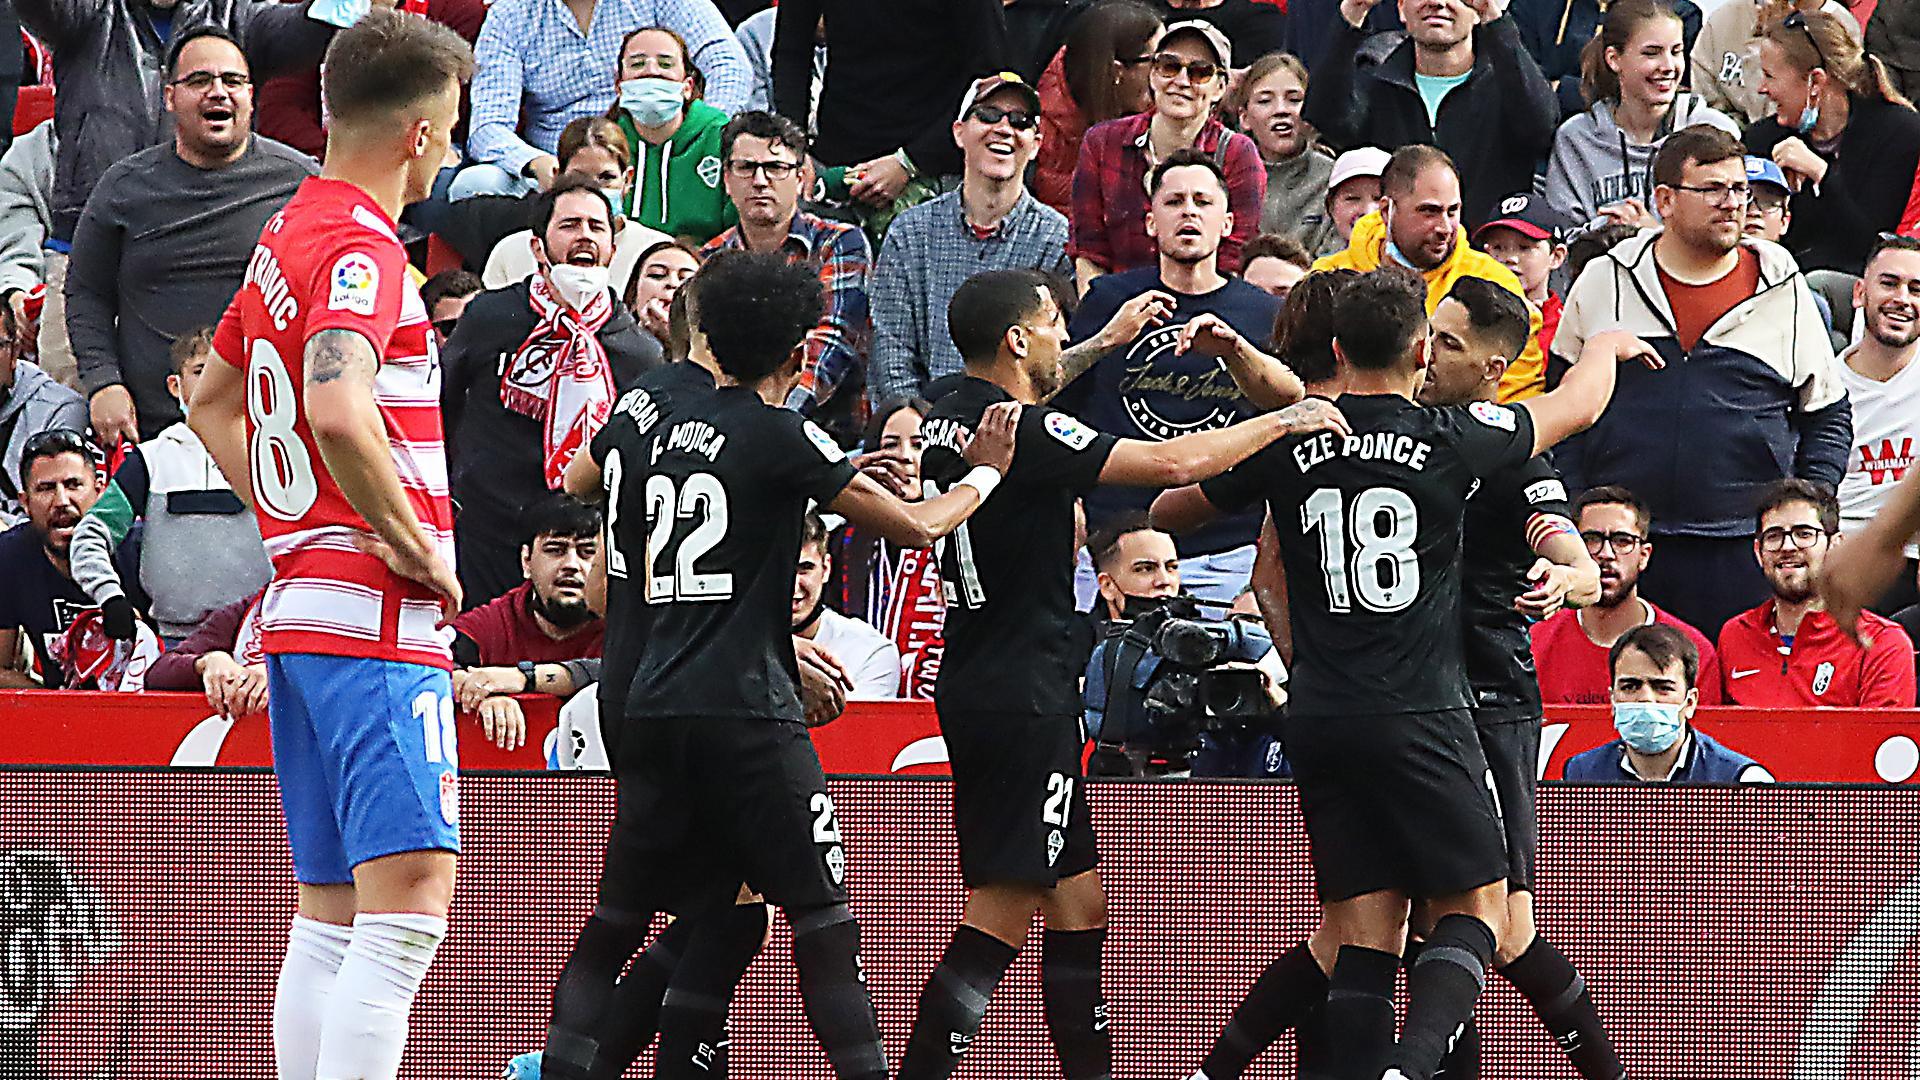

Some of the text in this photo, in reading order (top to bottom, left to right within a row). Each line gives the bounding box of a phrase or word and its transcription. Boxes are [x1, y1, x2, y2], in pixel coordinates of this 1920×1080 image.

[667, 420, 726, 463] MOJICA
[1292, 432, 1432, 474] EZE PONCE
[644, 472, 733, 605] 22
[1299, 486, 1422, 614] 18
[1043, 773, 1073, 829] 21
